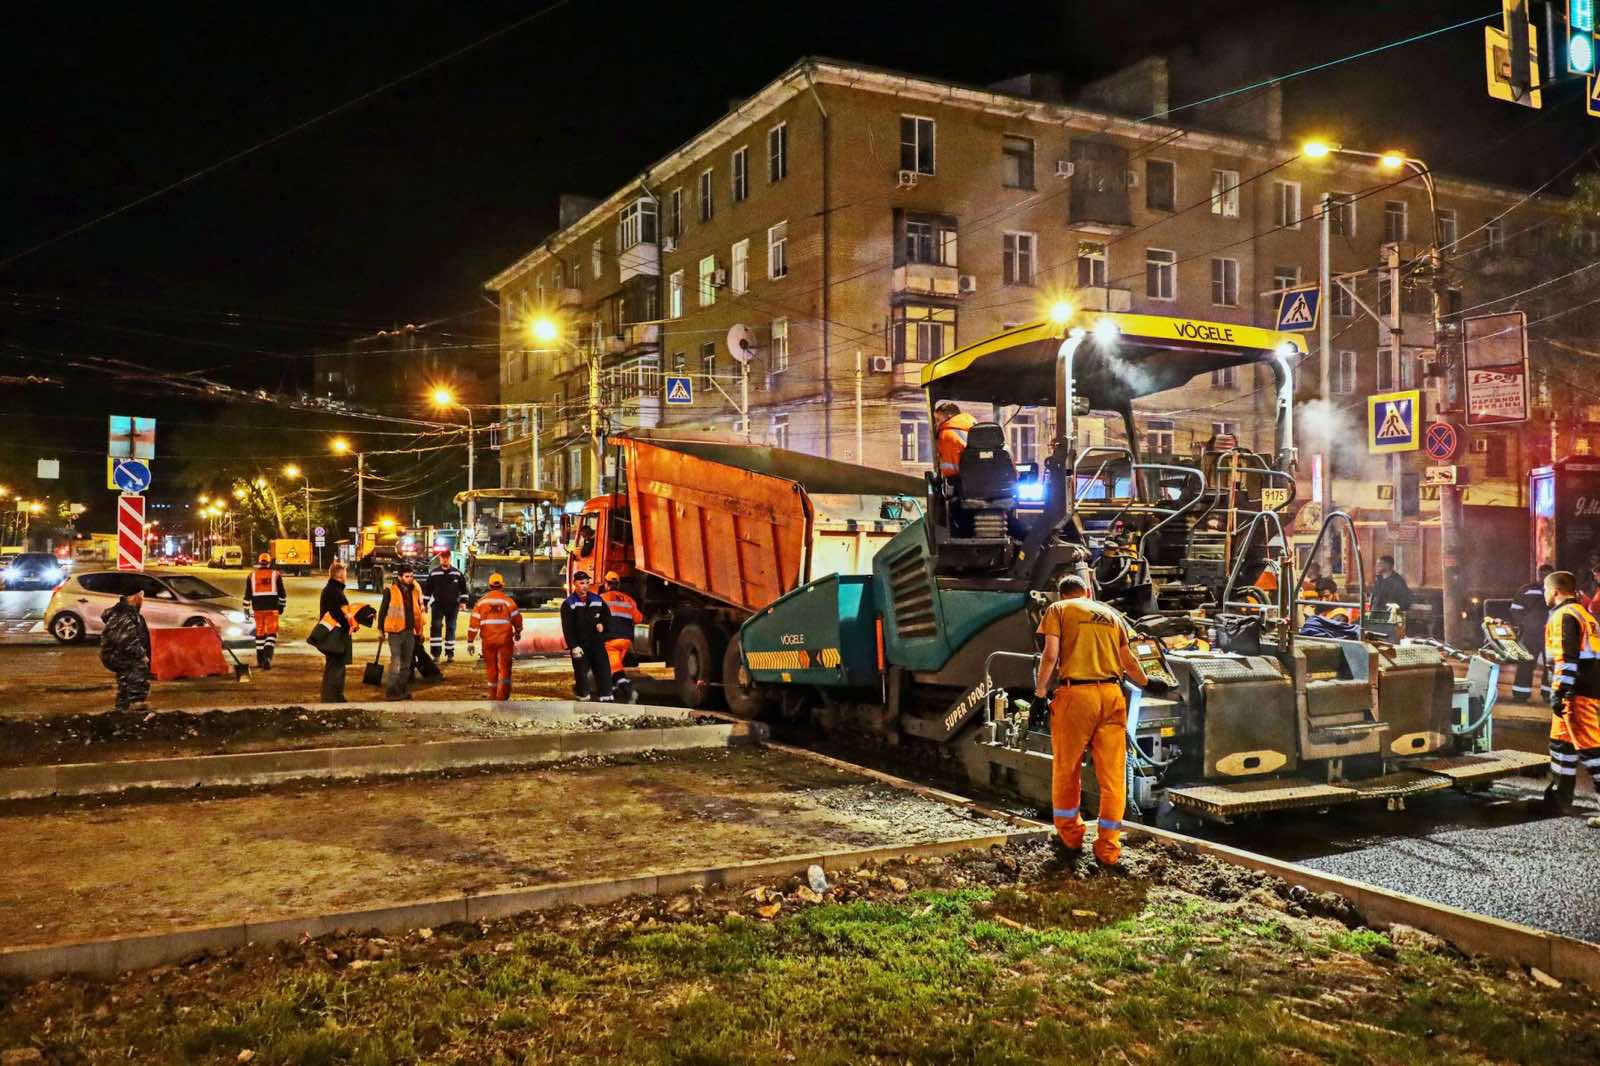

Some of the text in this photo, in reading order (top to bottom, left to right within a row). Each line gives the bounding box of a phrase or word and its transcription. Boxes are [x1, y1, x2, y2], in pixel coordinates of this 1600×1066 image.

[1173, 321, 1235, 343] VÖGELE
[1264, 490, 1285, 501] 9175
[945, 702, 967, 731] SUPER
